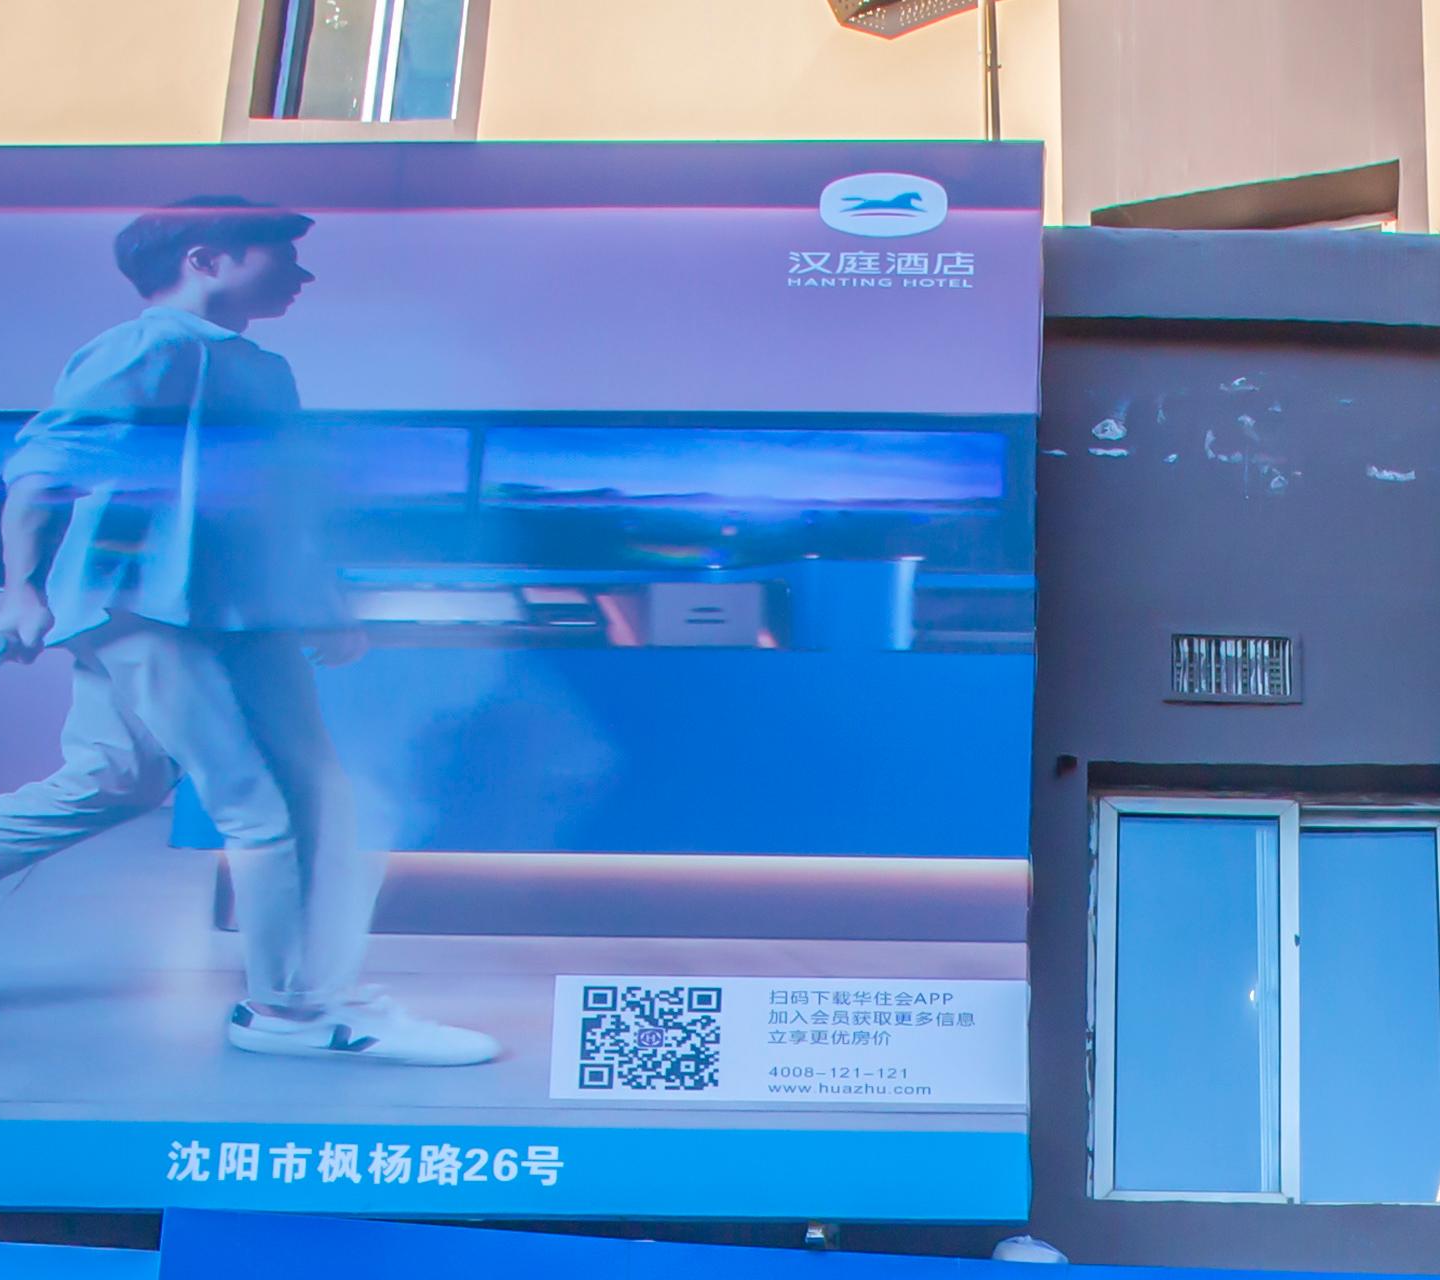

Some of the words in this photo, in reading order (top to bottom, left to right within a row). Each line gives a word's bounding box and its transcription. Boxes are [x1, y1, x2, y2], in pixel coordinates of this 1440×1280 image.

[788, 250, 974, 275] 汉庭酒店
[788, 278, 892, 288] HANTING
[904, 278, 973, 288] HOTEL
[768, 989, 954, 1007] 扫码下载华住会APP
[767, 1009, 976, 1029] 加入会员获取更多信息
[767, 1029, 892, 1047] 立享更优房价
[768, 1066, 909, 1079] 4008-121-121
[767, 1082, 932, 1096] www.huazhu.com
[166, 1140, 565, 1186] 沈阳市枫杨路26号
